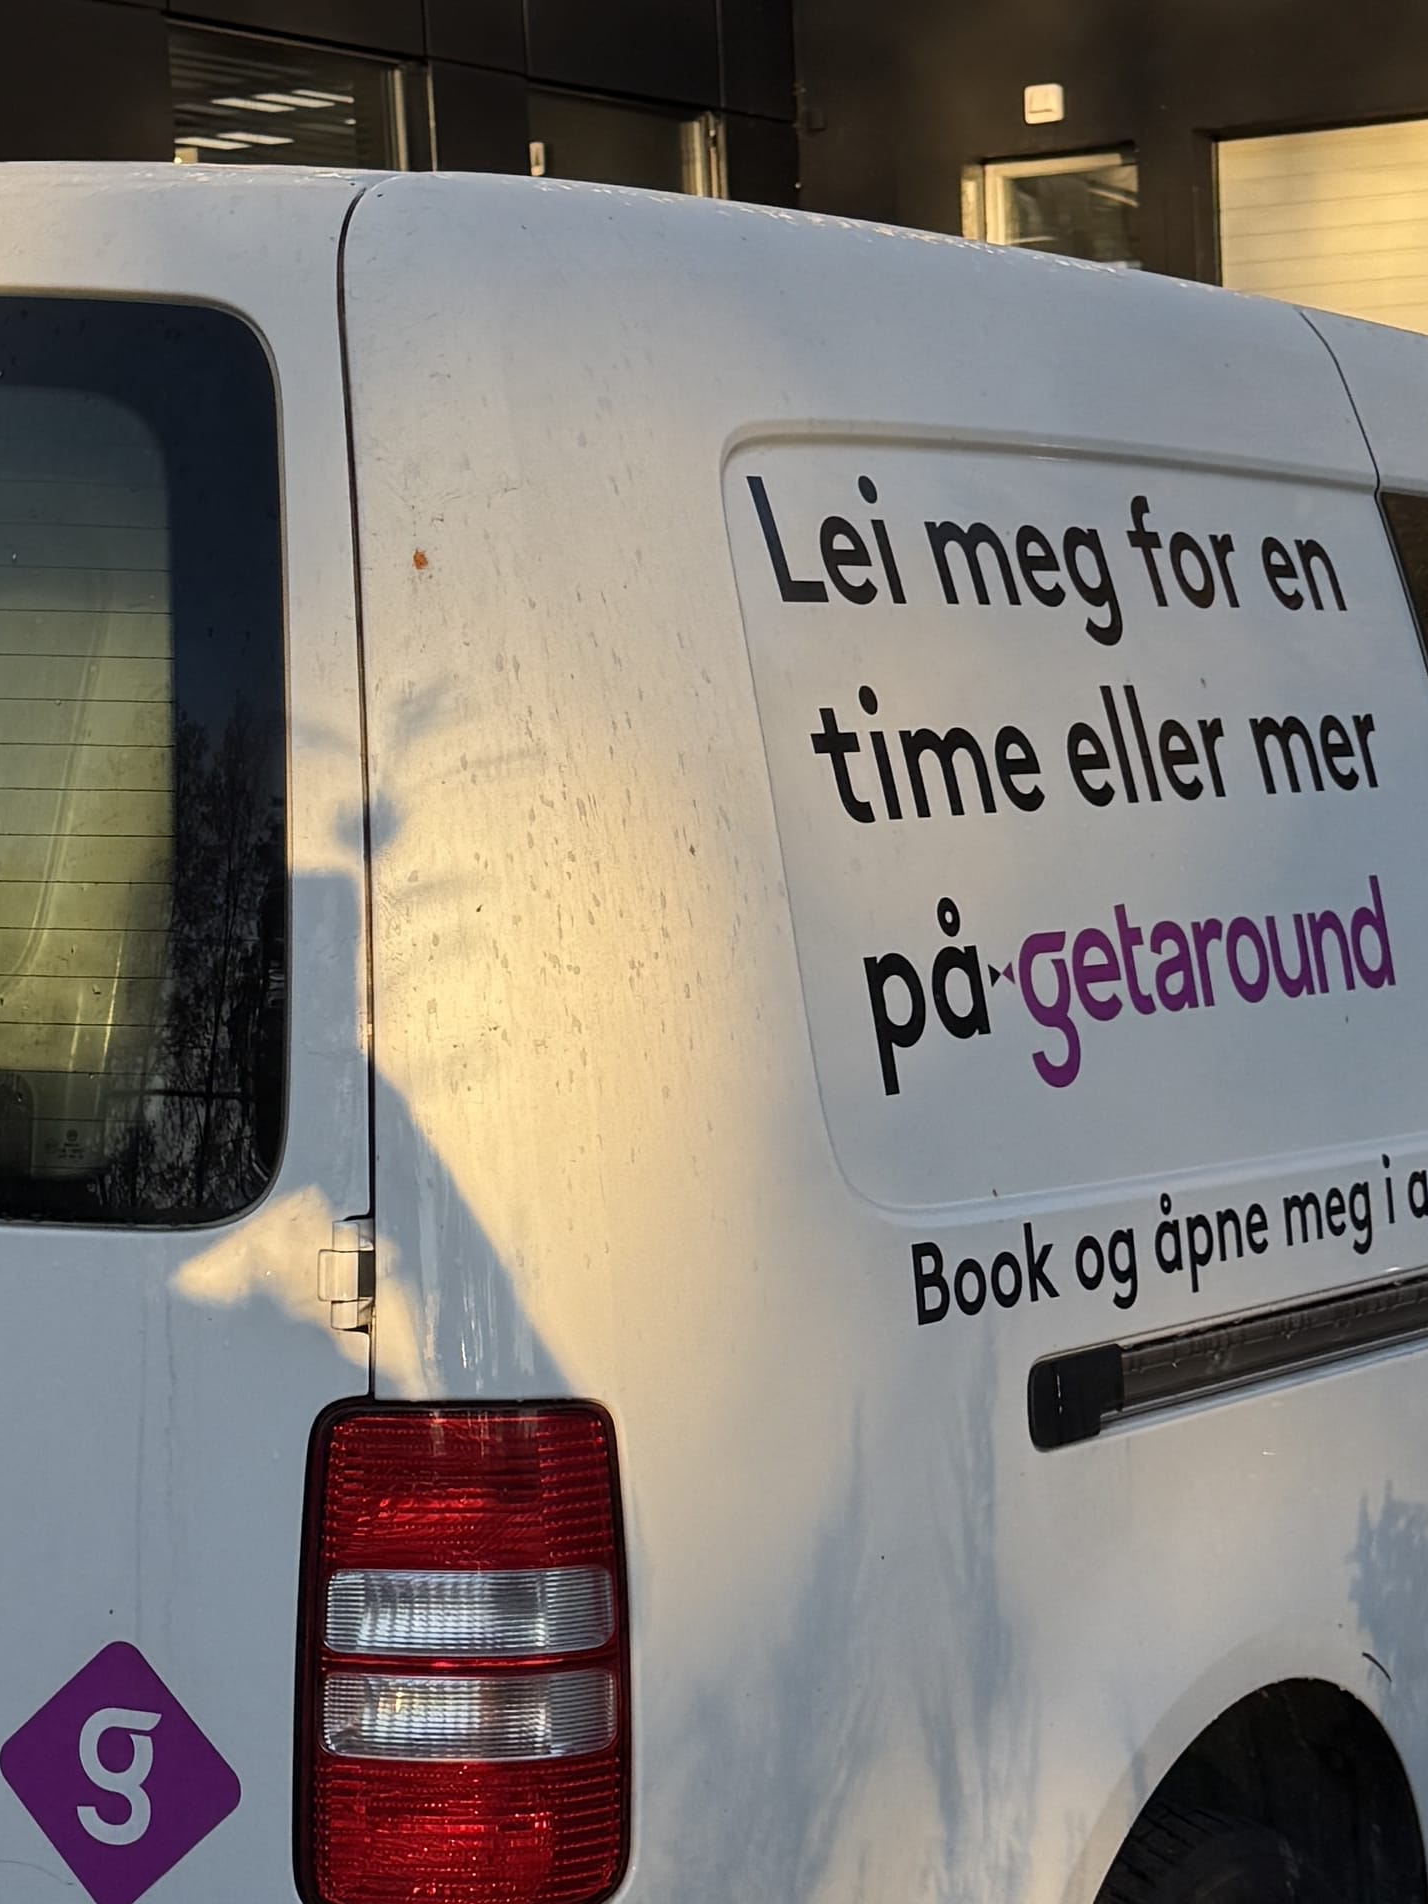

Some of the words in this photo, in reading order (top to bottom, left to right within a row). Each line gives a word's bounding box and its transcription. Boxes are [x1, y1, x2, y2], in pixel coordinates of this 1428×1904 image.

[745, 474, 907, 606] Lei
[924, 519, 1124, 647] meg
[1127, 495, 1236, 609] for
[1261, 533, 1347, 612] en
[810, 685, 1046, 824] time
[1067, 684, 1228, 807] eller
[1251, 710, 1379, 797] mer
[863, 898, 992, 1096] på
[1017, 876, 1396, 1089] getaround
[911, 1222, 1061, 1326] Book
[1075, 1232, 1139, 1309] og
[1154, 1192, 1270, 1292] åpne
[1283, 1176, 1372, 1253] meg
[1381, 1154, 1398, 1224] i
[76, 1707, 162, 1846] g
